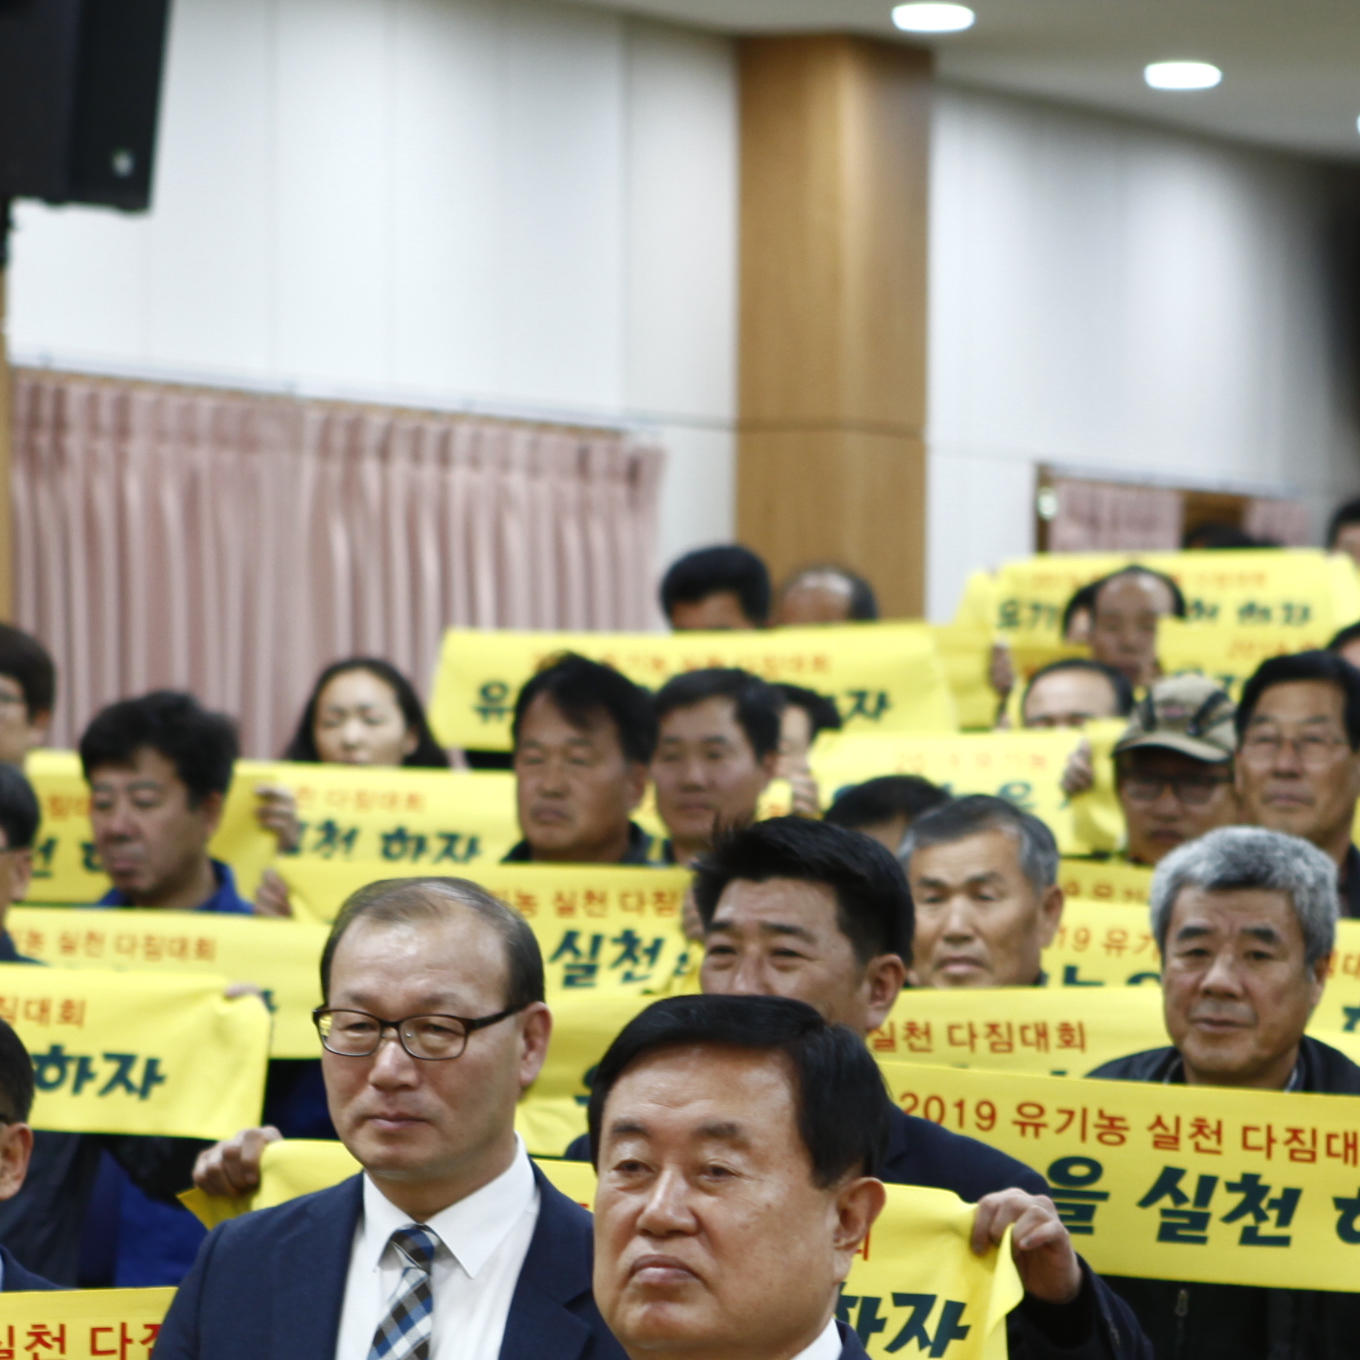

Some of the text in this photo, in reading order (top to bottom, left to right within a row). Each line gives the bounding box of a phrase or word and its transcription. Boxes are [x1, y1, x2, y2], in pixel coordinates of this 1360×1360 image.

[379, 826, 481, 864] 하자
[620, 889, 678, 921] 다짐
[549, 929, 665, 990] 실천
[946, 1020, 1087, 1054] 다짐대회
[32, 1044, 166, 1099] 하자
[901, 1092, 998, 1133] 2019
[1011, 1103, 1131, 1147] 유기농
[1145, 1113, 1226, 1156] 실천
[1136, 1165, 1302, 1248] 실천
